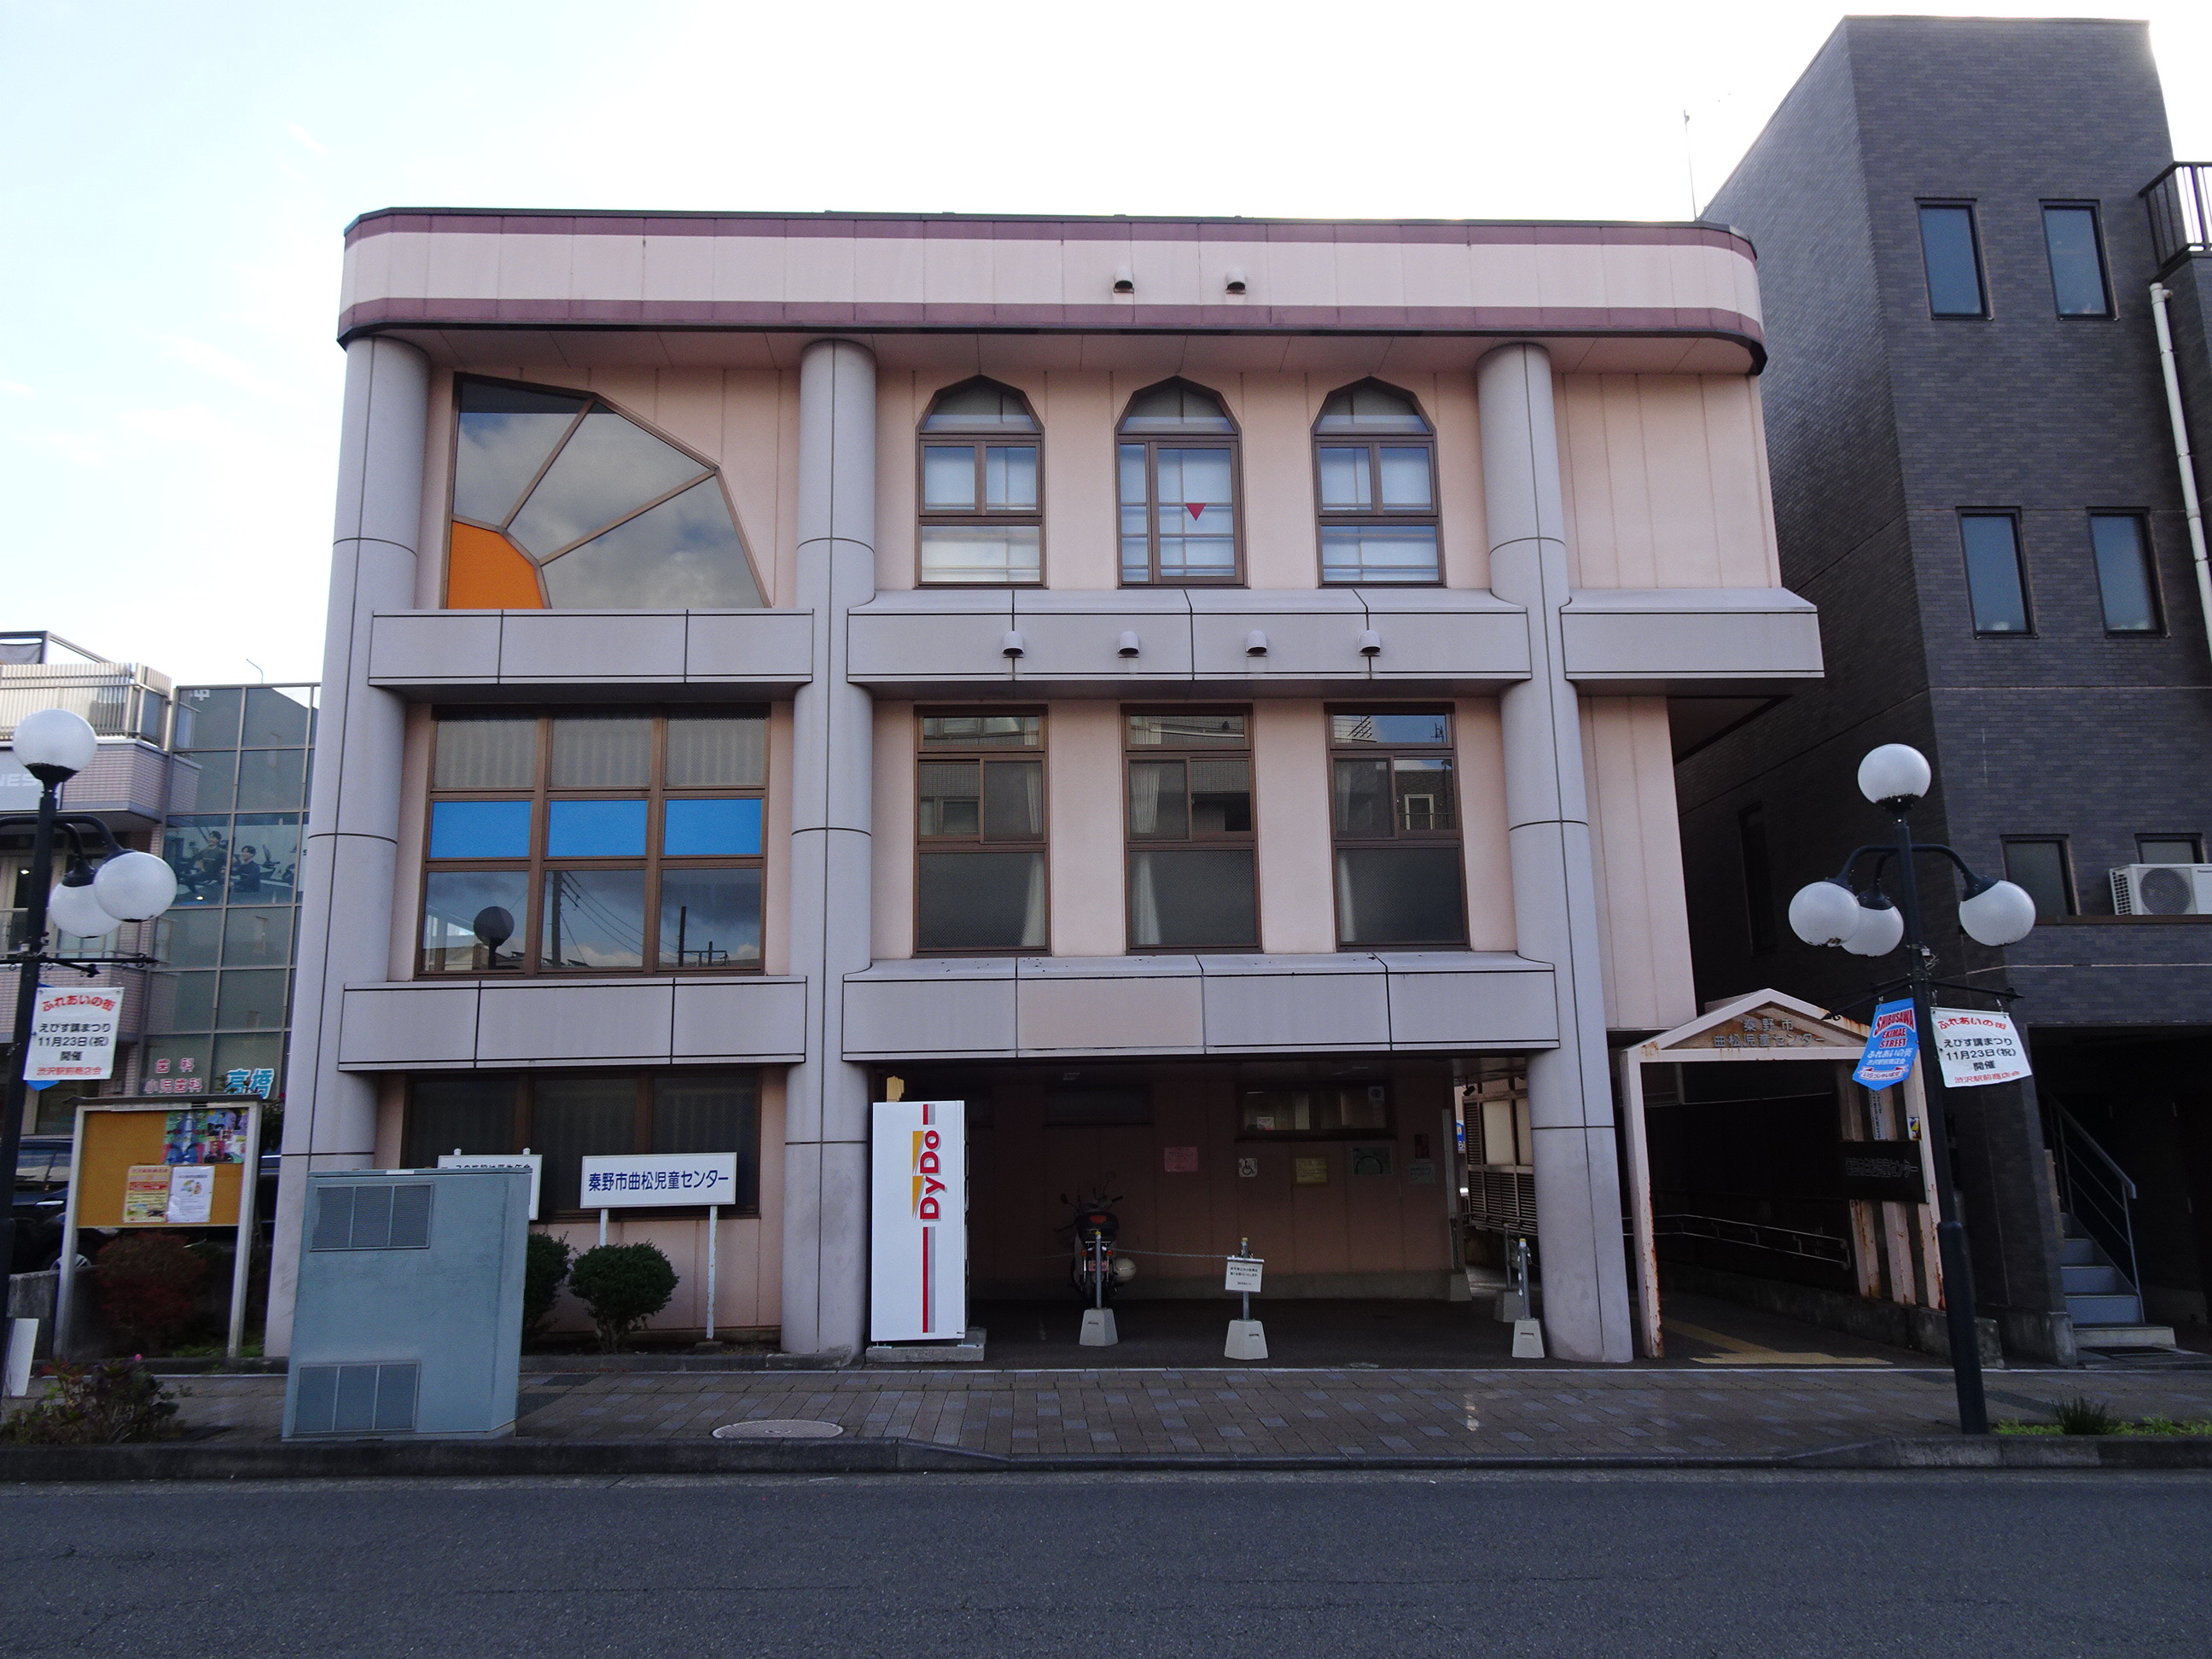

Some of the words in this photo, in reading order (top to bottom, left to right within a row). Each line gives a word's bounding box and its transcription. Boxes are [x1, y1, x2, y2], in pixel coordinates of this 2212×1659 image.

[41, 994, 116, 1011] ふれあいの街
[38, 1022, 112, 1033] えびす講まつり
[1743, 1018, 1795, 1032] 秦野市
[1873, 1009, 1915, 1036] SHIBUSAWA
[1937, 1016, 2007, 1030] ふれあいの街
[1714, 1033, 1825, 1047] 曲松児童センター
[1882, 1027, 1906, 1039] EKIMAE
[1879, 1039, 1907, 1049] STREET
[1943, 1038, 2013, 1048] えびす講まつり
[60, 1051, 83, 1061] 開催
[1946, 1048, 2017, 1061] 11月23日(祝)
[1973, 1060, 1996, 1071] 開催
[143, 1077, 203, 1094] 小児歯科
[589, 1170, 730, 1191] 秦野市曲松児童センター
[919, 1129, 946, 1220] DyDo
